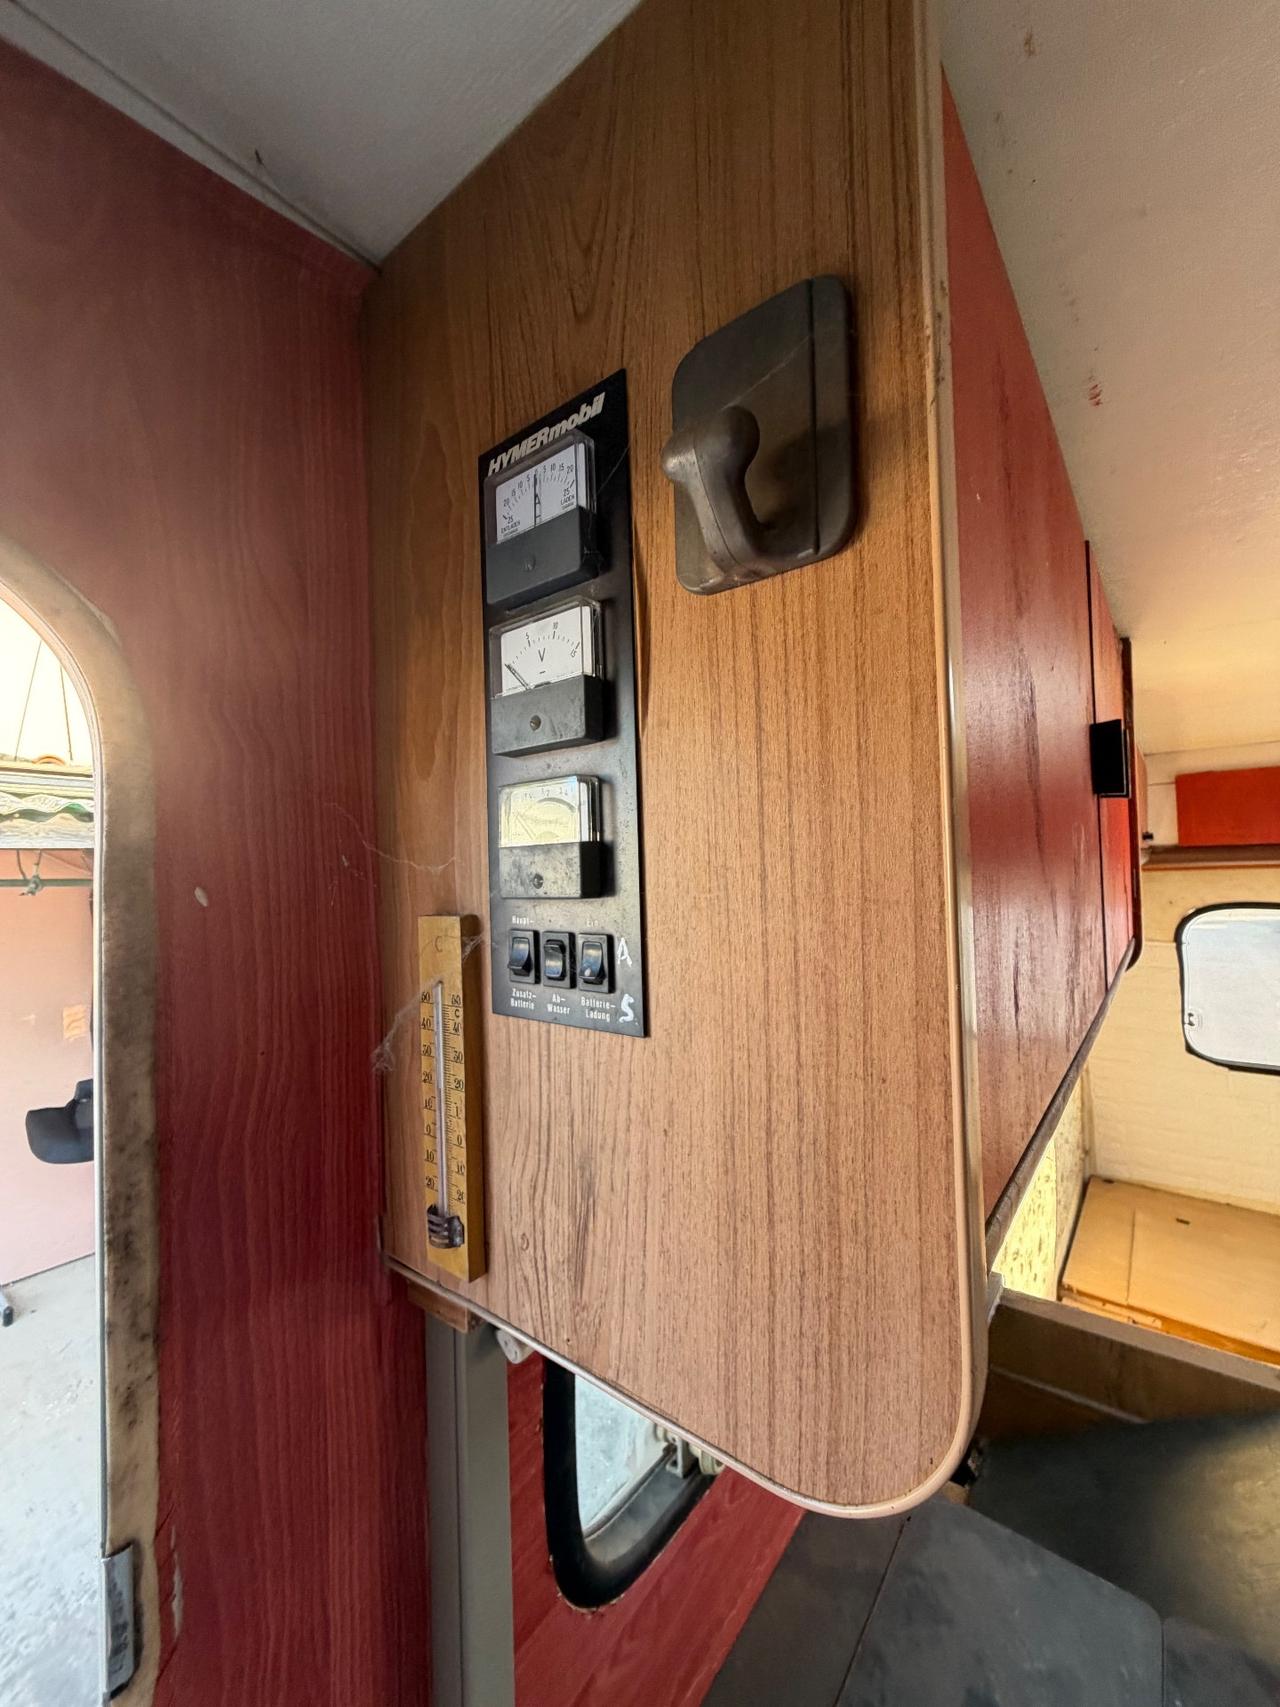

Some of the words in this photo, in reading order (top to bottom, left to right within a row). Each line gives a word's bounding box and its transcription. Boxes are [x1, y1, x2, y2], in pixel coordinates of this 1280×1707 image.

[488, 391, 605, 477] HYMERmobil
[525, 632, 530, 640] 5
[538, 647, 546, 662] V
[552, 993, 566, 1004] Ab-
[580, 996, 616, 1010] Batterie-
[454, 1008, 460, 1018] C
[547, 1003, 570, 1014] Wasser
[585, 1008, 611, 1022] Ladung
[421, 1018, 431, 1030] 40
[422, 1046, 432, 1057] 30
[453, 1051, 463, 1063] 30
[423, 1071, 433, 1083] 20
[454, 1078, 464, 1089] 20
[457, 1135, 463, 1146] 0
[426, 1150, 435, 1162] 10
[426, 1176, 435, 1188] 20
